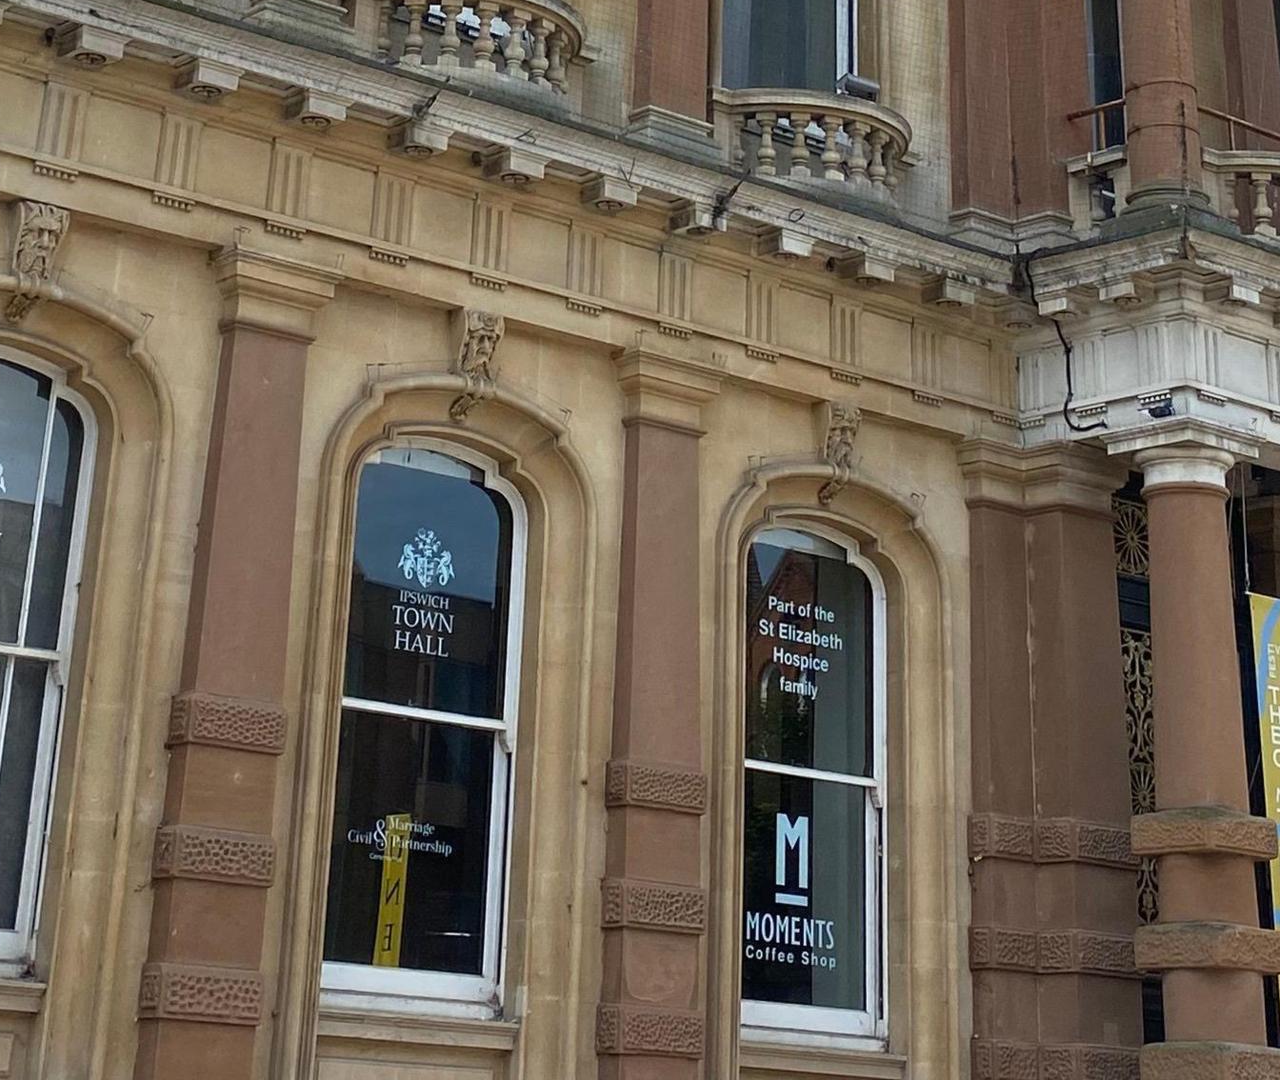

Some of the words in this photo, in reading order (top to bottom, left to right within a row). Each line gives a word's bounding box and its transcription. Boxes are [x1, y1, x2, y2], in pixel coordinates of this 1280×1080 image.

[400, 589, 449, 610] IPSWICH
[768, 595, 795, 615] Part
[798, 603, 811, 618] of
[814, 606, 835, 622] the
[392, 605, 454, 634] TOWN
[393, 629, 449, 657] HALL
[759, 618, 775, 637] St
[779, 623, 843, 651] Elizabeth
[773, 646, 829, 672] Hospice
[780, 676, 818, 700] family
[347, 829, 372, 845] Civil
[373, 819, 389, 851] &
[392, 834, 453, 857] Partnership
[388, 816, 435, 837] Marriage
[775, 813, 809, 889] M
[746, 911, 834, 950] MOMENTS
[745, 944, 794, 964] Coffee
[801, 951, 837, 970] Shop
